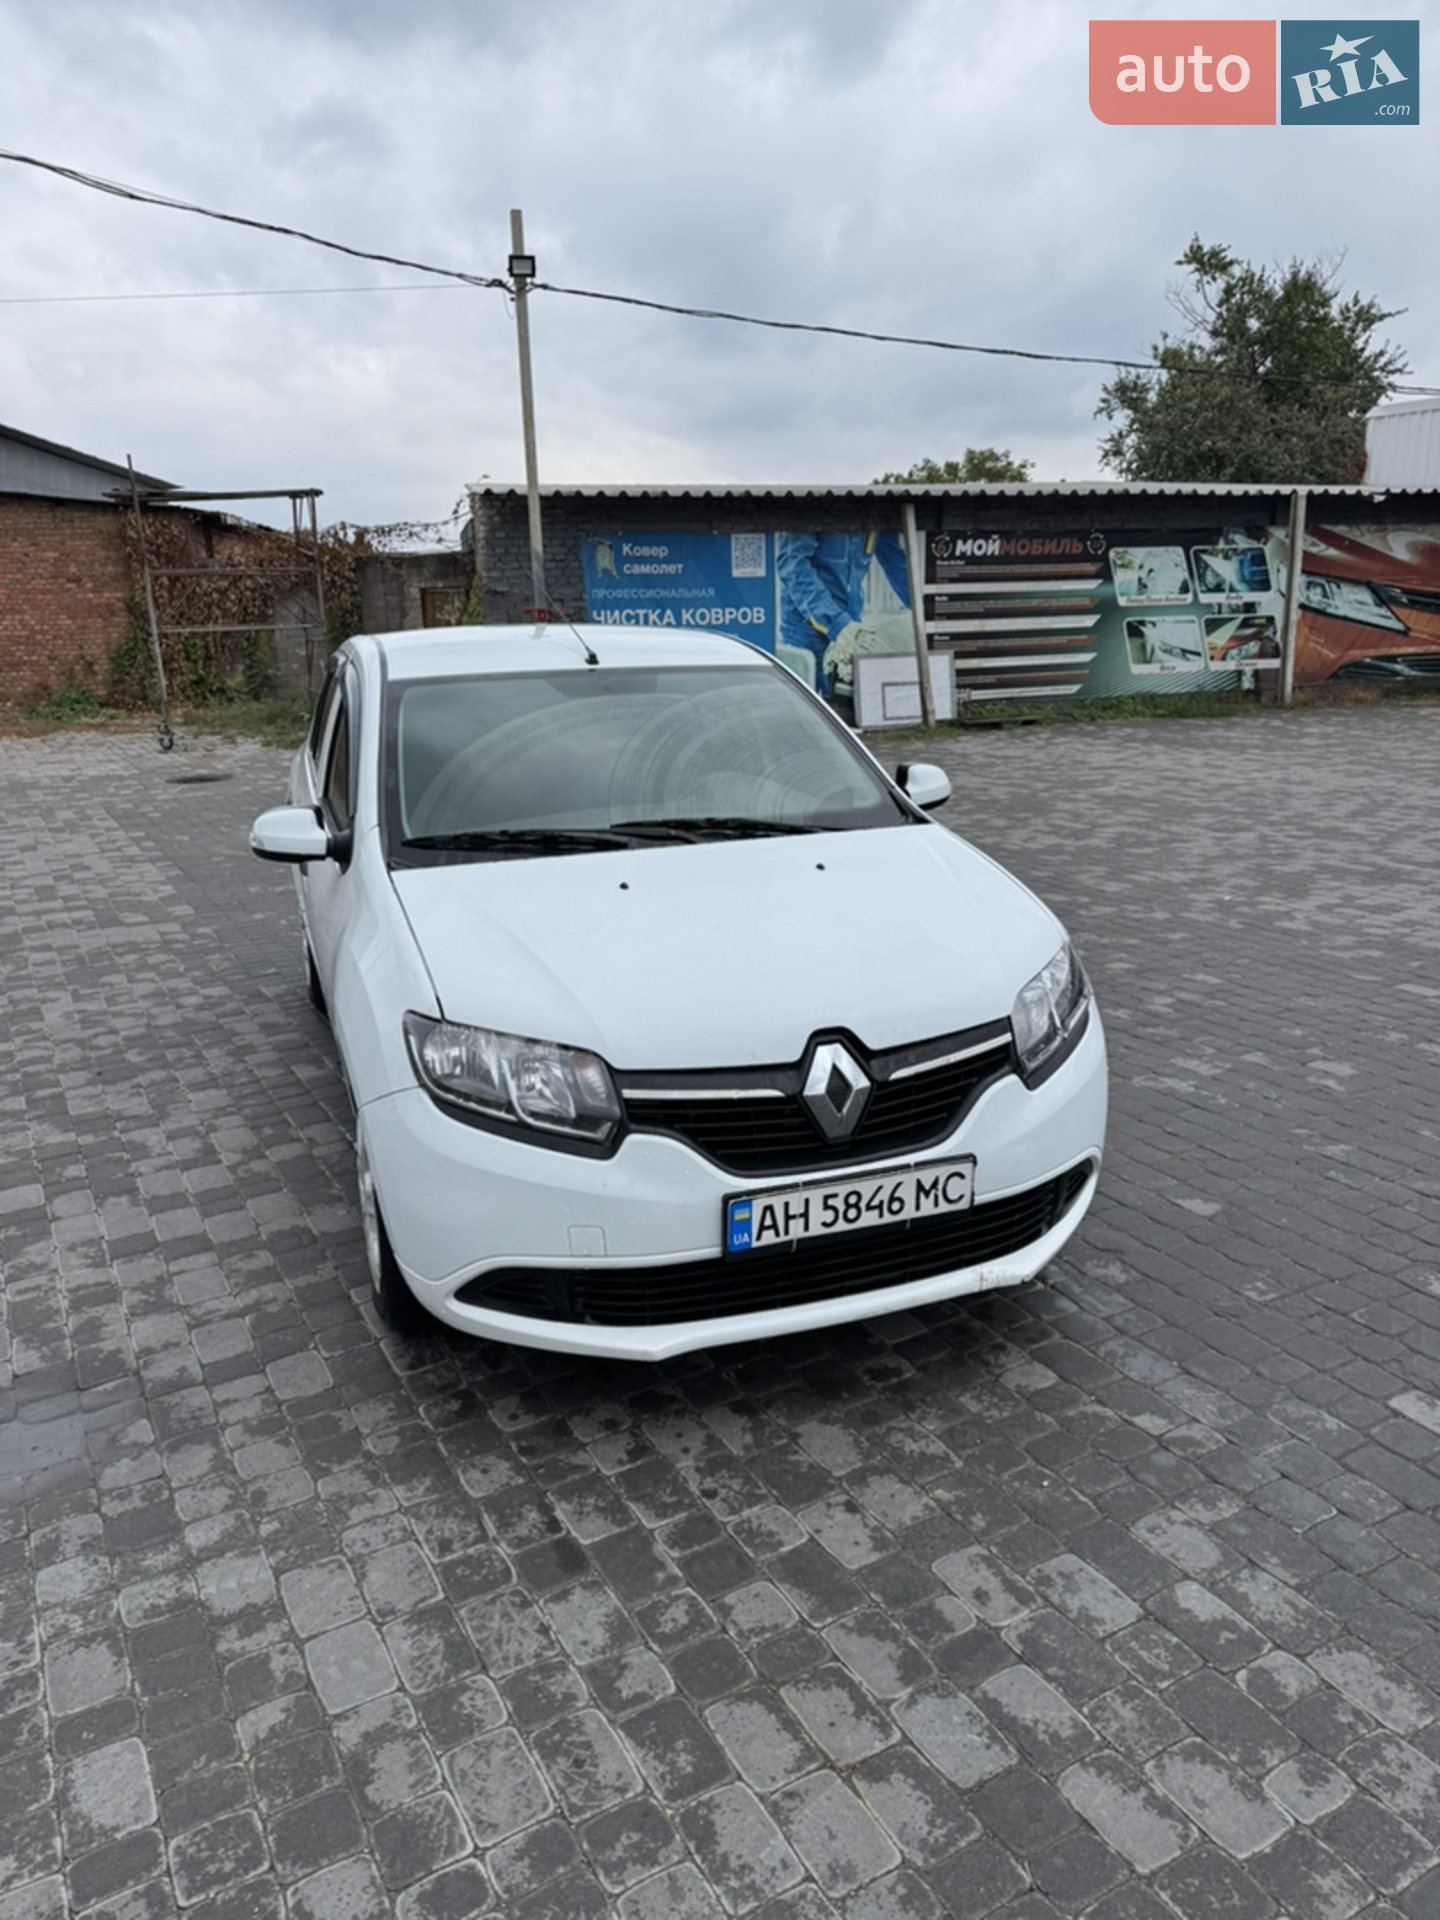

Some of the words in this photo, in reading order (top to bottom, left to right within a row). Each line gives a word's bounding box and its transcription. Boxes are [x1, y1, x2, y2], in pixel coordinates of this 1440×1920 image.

[622, 543, 669, 557] Ковер
[623, 563, 684, 575] самолет
[592, 588, 715, 599] ПРОФЕССИОНАЛЬНАЯ
[592, 608, 676, 626] ЧИСТКА
[682, 607, 765, 626] КОВРОВ
[755, 1197, 810, 1242] AH
[820, 1181, 905, 1229] 5846
[915, 1171, 966, 1212] MC
[733, 1232, 750, 1245] UA
